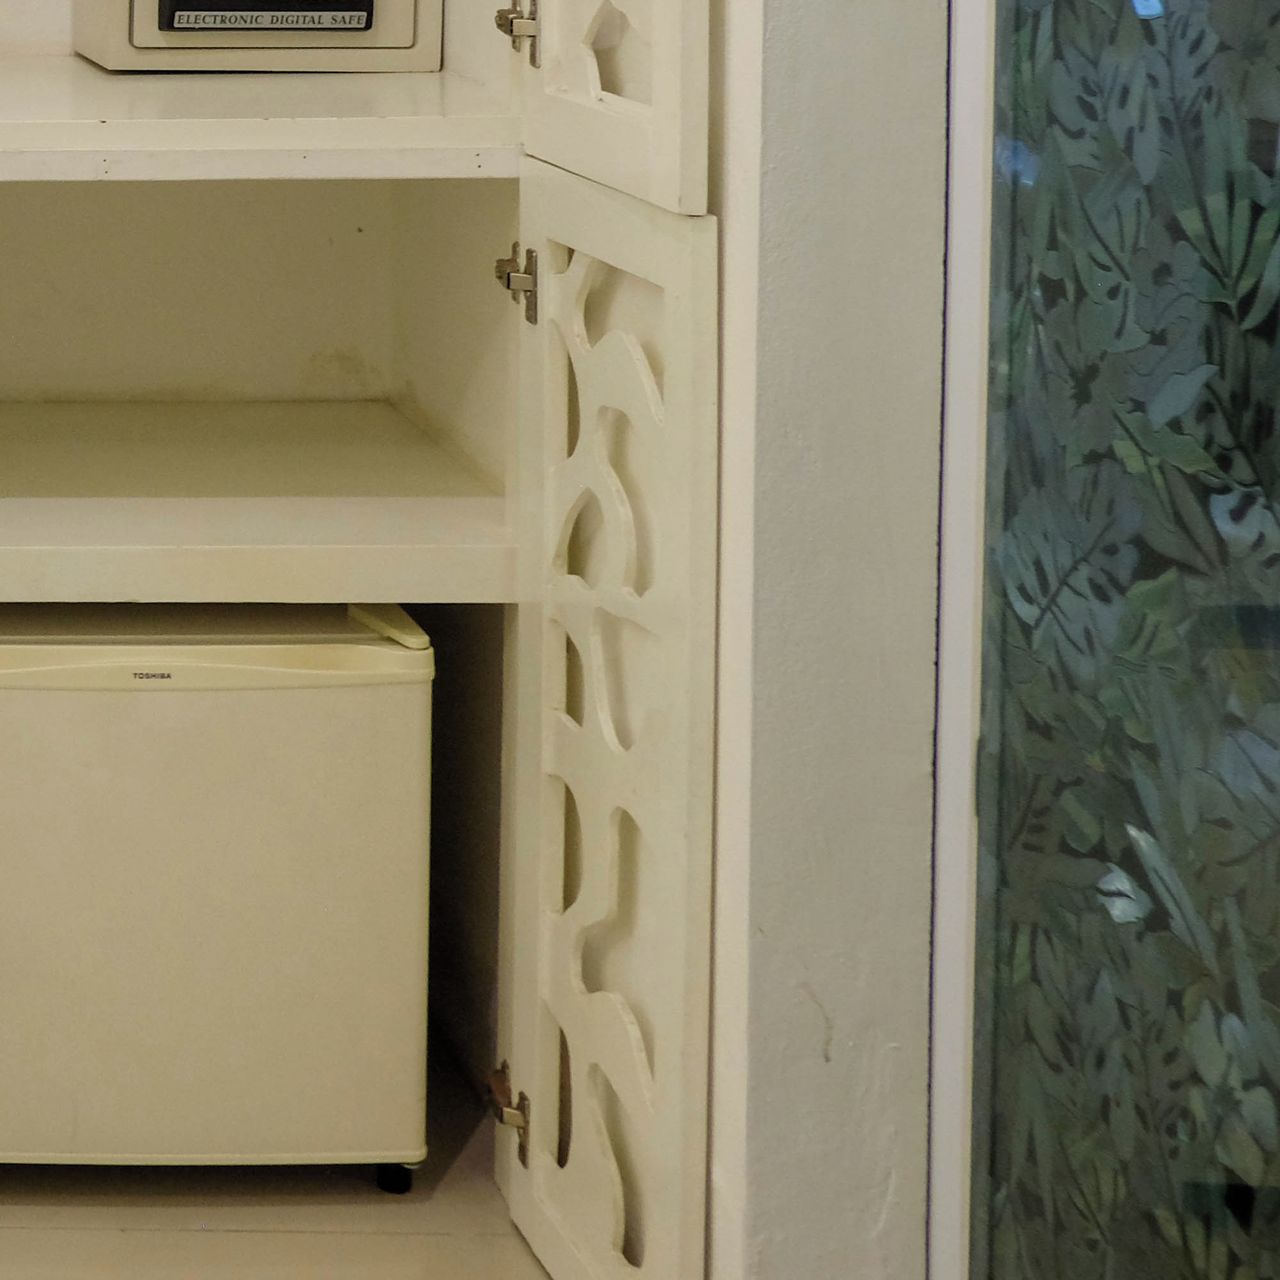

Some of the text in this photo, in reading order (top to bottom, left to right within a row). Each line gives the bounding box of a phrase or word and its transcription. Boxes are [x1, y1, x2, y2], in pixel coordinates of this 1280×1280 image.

[176, 14, 366, 25] ELECTRONIC DIGITAL SAFE
